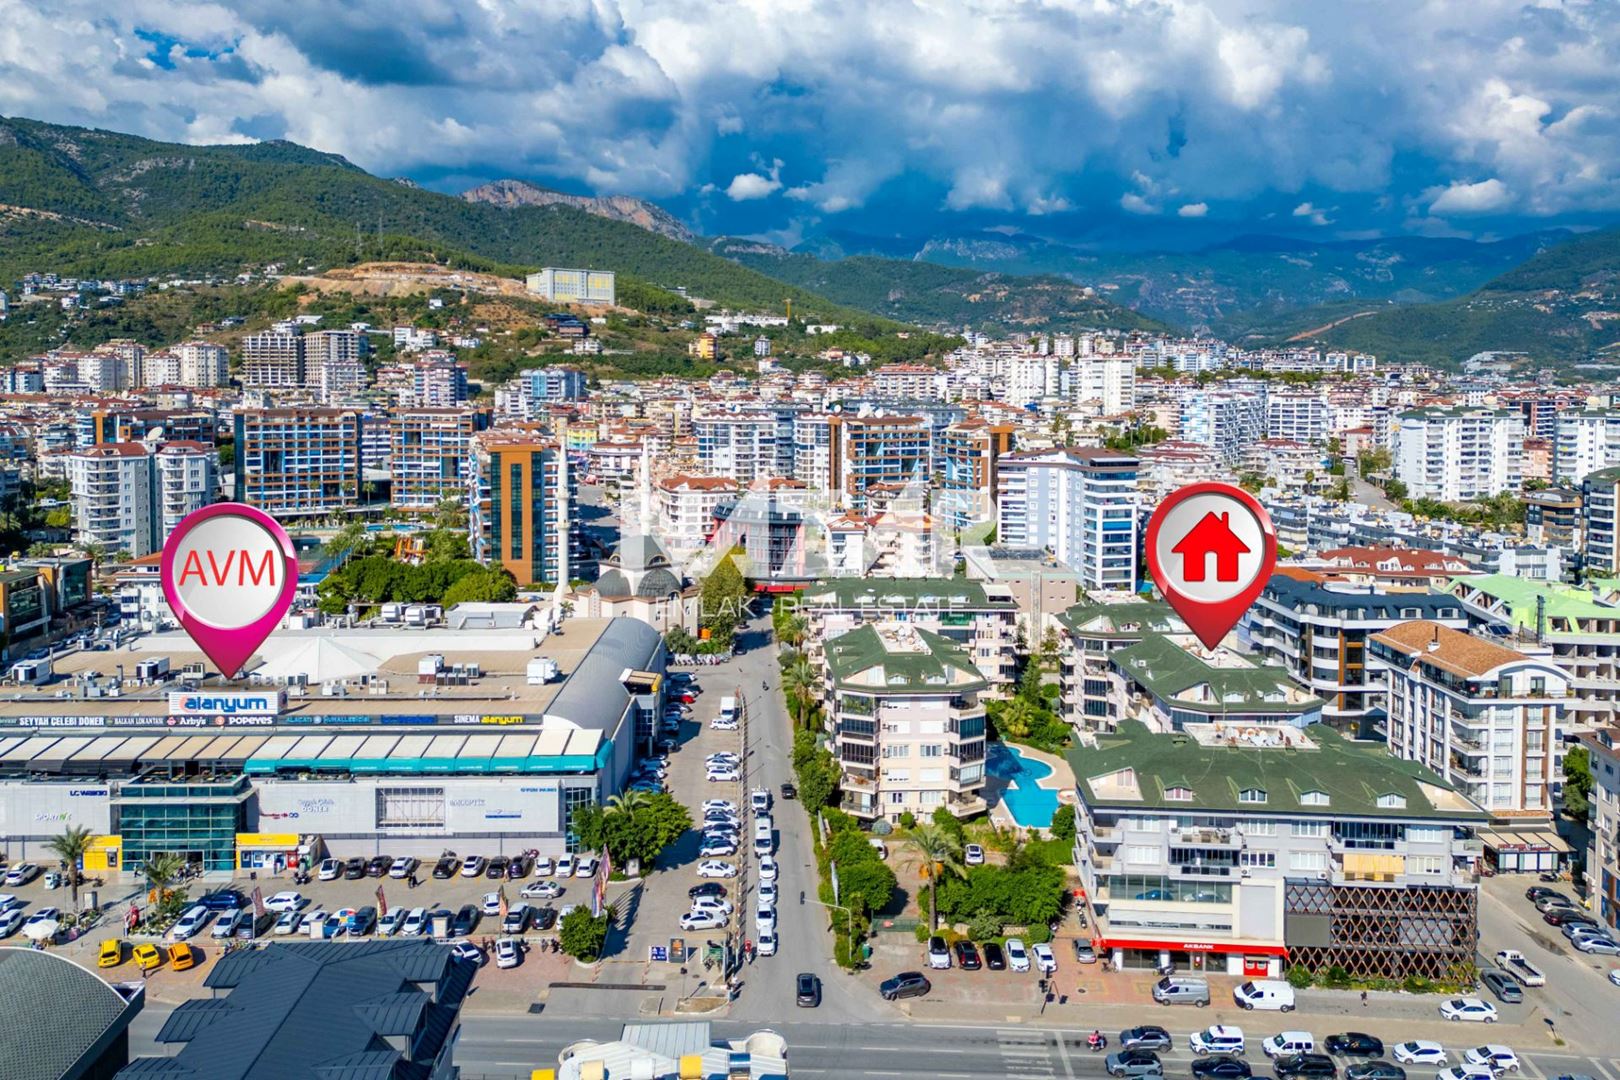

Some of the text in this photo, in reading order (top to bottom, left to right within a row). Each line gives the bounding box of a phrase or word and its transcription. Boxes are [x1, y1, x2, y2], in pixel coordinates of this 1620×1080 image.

[184, 696, 268, 713] alanyum
[20, 716, 49, 726] SEYYAH
[179, 716, 207, 727] Arby's
